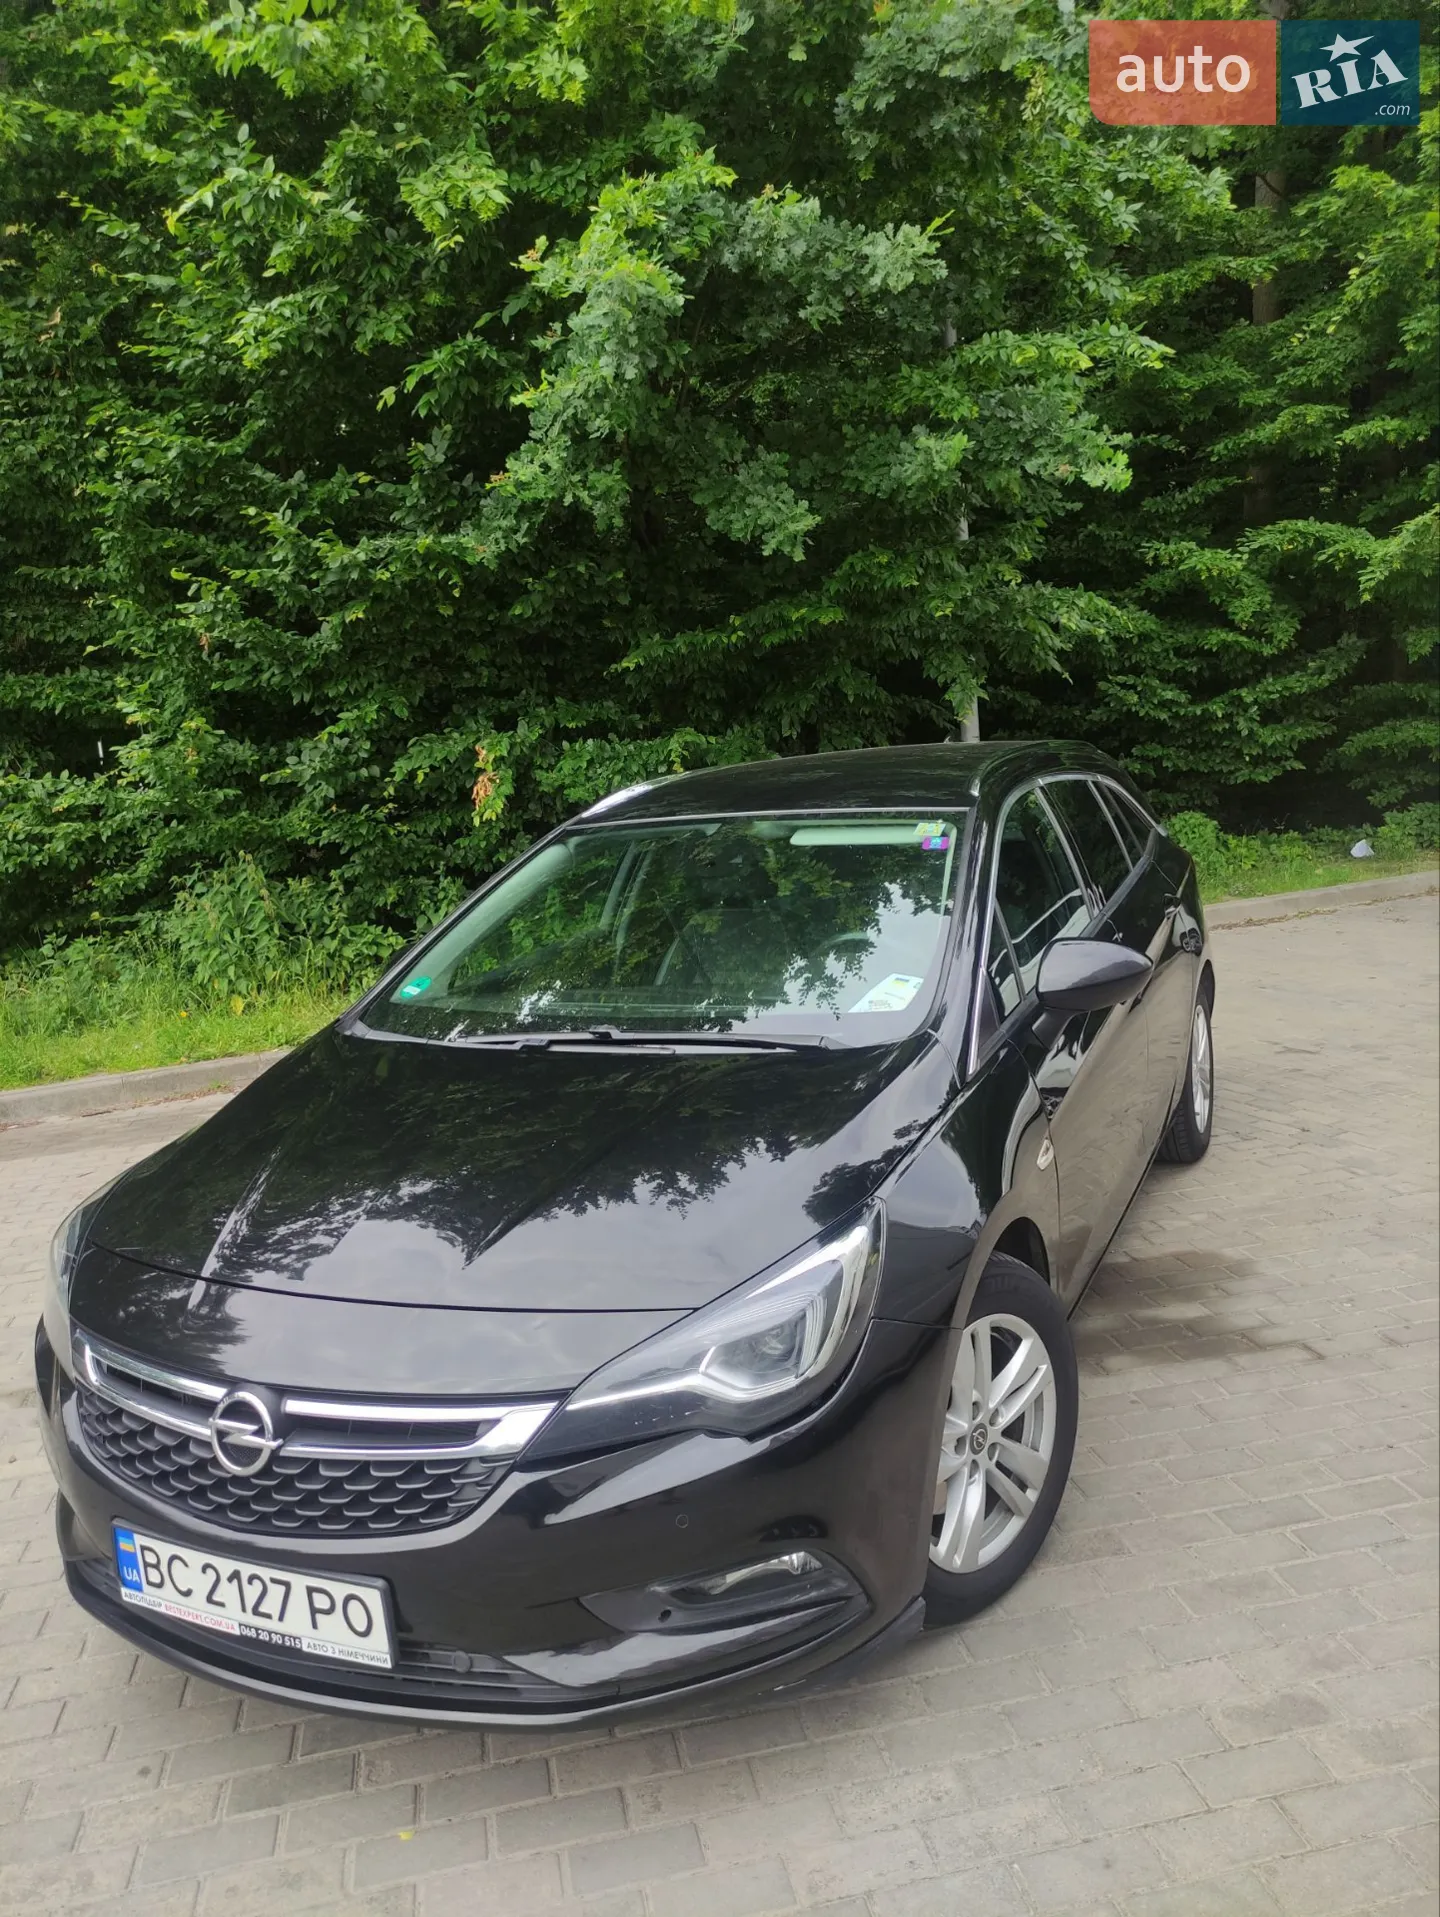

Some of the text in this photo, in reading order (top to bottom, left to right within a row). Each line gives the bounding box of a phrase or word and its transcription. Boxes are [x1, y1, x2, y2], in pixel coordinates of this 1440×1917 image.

[124, 1567, 140, 1582] UA
[140, 1544, 374, 1637] BC 2127 PO
[240, 1625, 301, 1649] 068 20 90 515
[307, 1641, 328, 1652] АВТО
[338, 1649, 388, 1665] НІМЕЧЧИНИ
